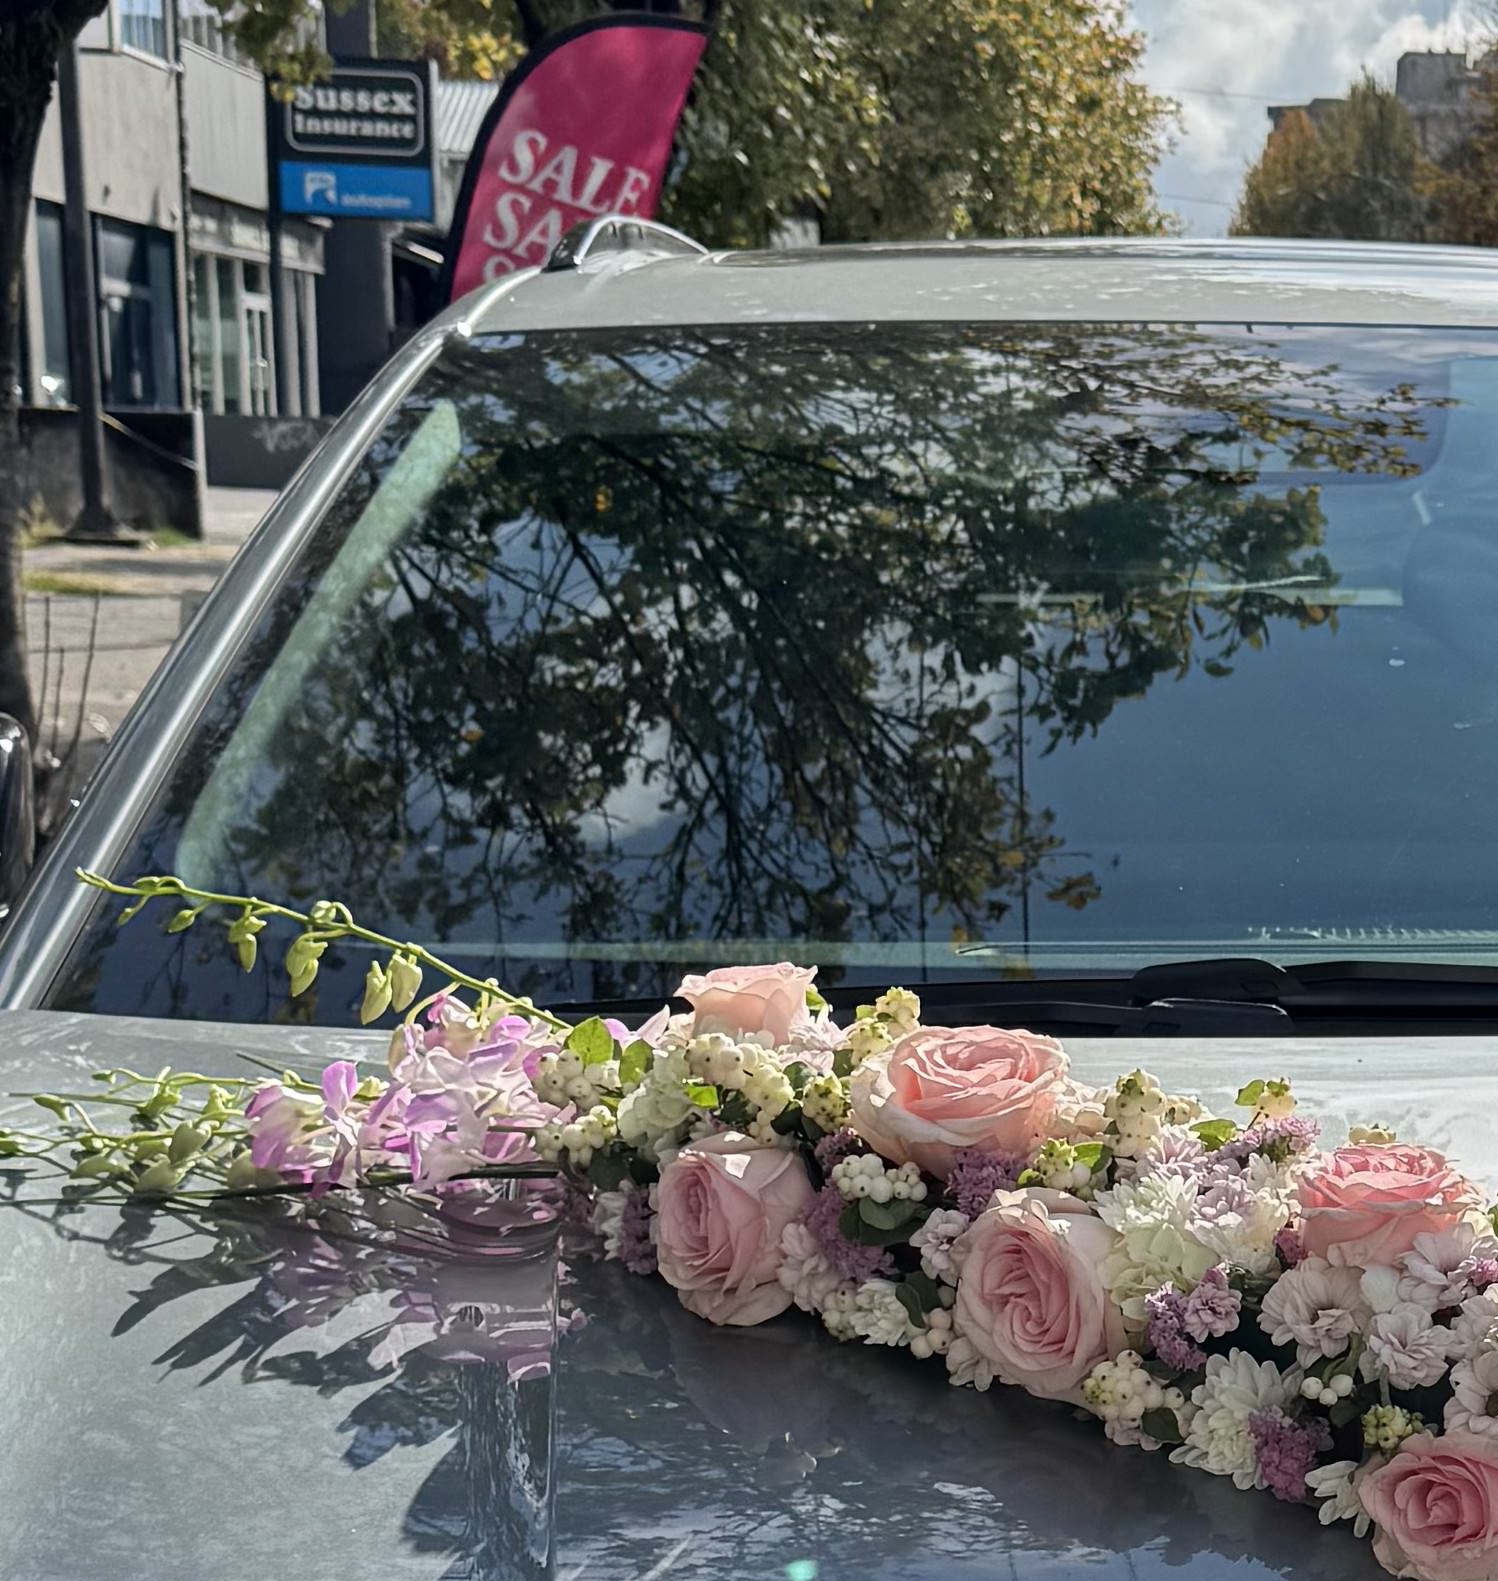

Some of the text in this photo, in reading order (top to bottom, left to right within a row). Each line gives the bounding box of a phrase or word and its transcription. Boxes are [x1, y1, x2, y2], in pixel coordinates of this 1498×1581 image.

[294, 84, 417, 115] Sussex
[294, 112, 416, 139] Insurance
[498, 129, 651, 218] SALE
[483, 191, 564, 268] SA
